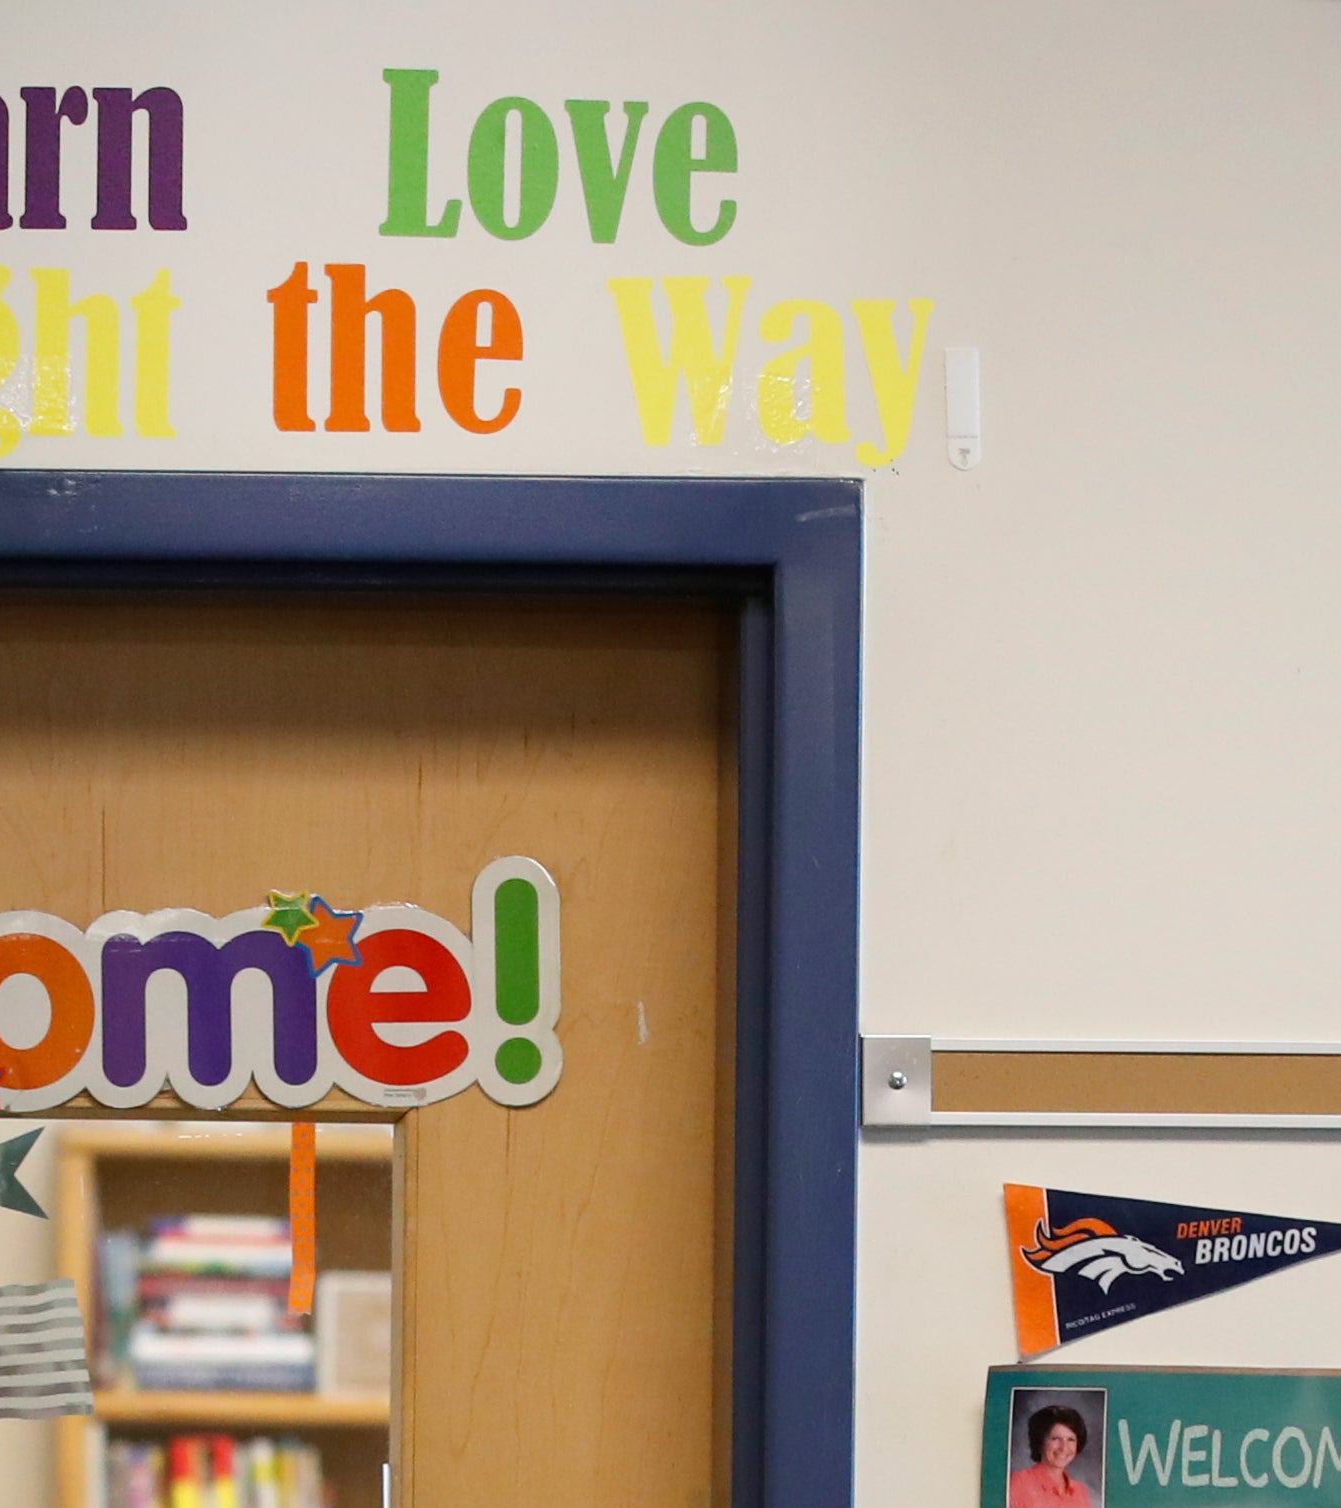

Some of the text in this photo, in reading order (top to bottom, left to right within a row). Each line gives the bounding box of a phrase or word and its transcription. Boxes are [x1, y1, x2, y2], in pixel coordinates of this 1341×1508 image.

[378, 68, 739, 247] Love
[267, 262, 524, 434] the
[606, 276, 935, 468] Way
[1176, 1216, 1244, 1239] DENVER
[1195, 1227, 1317, 1264] BRONCOS
